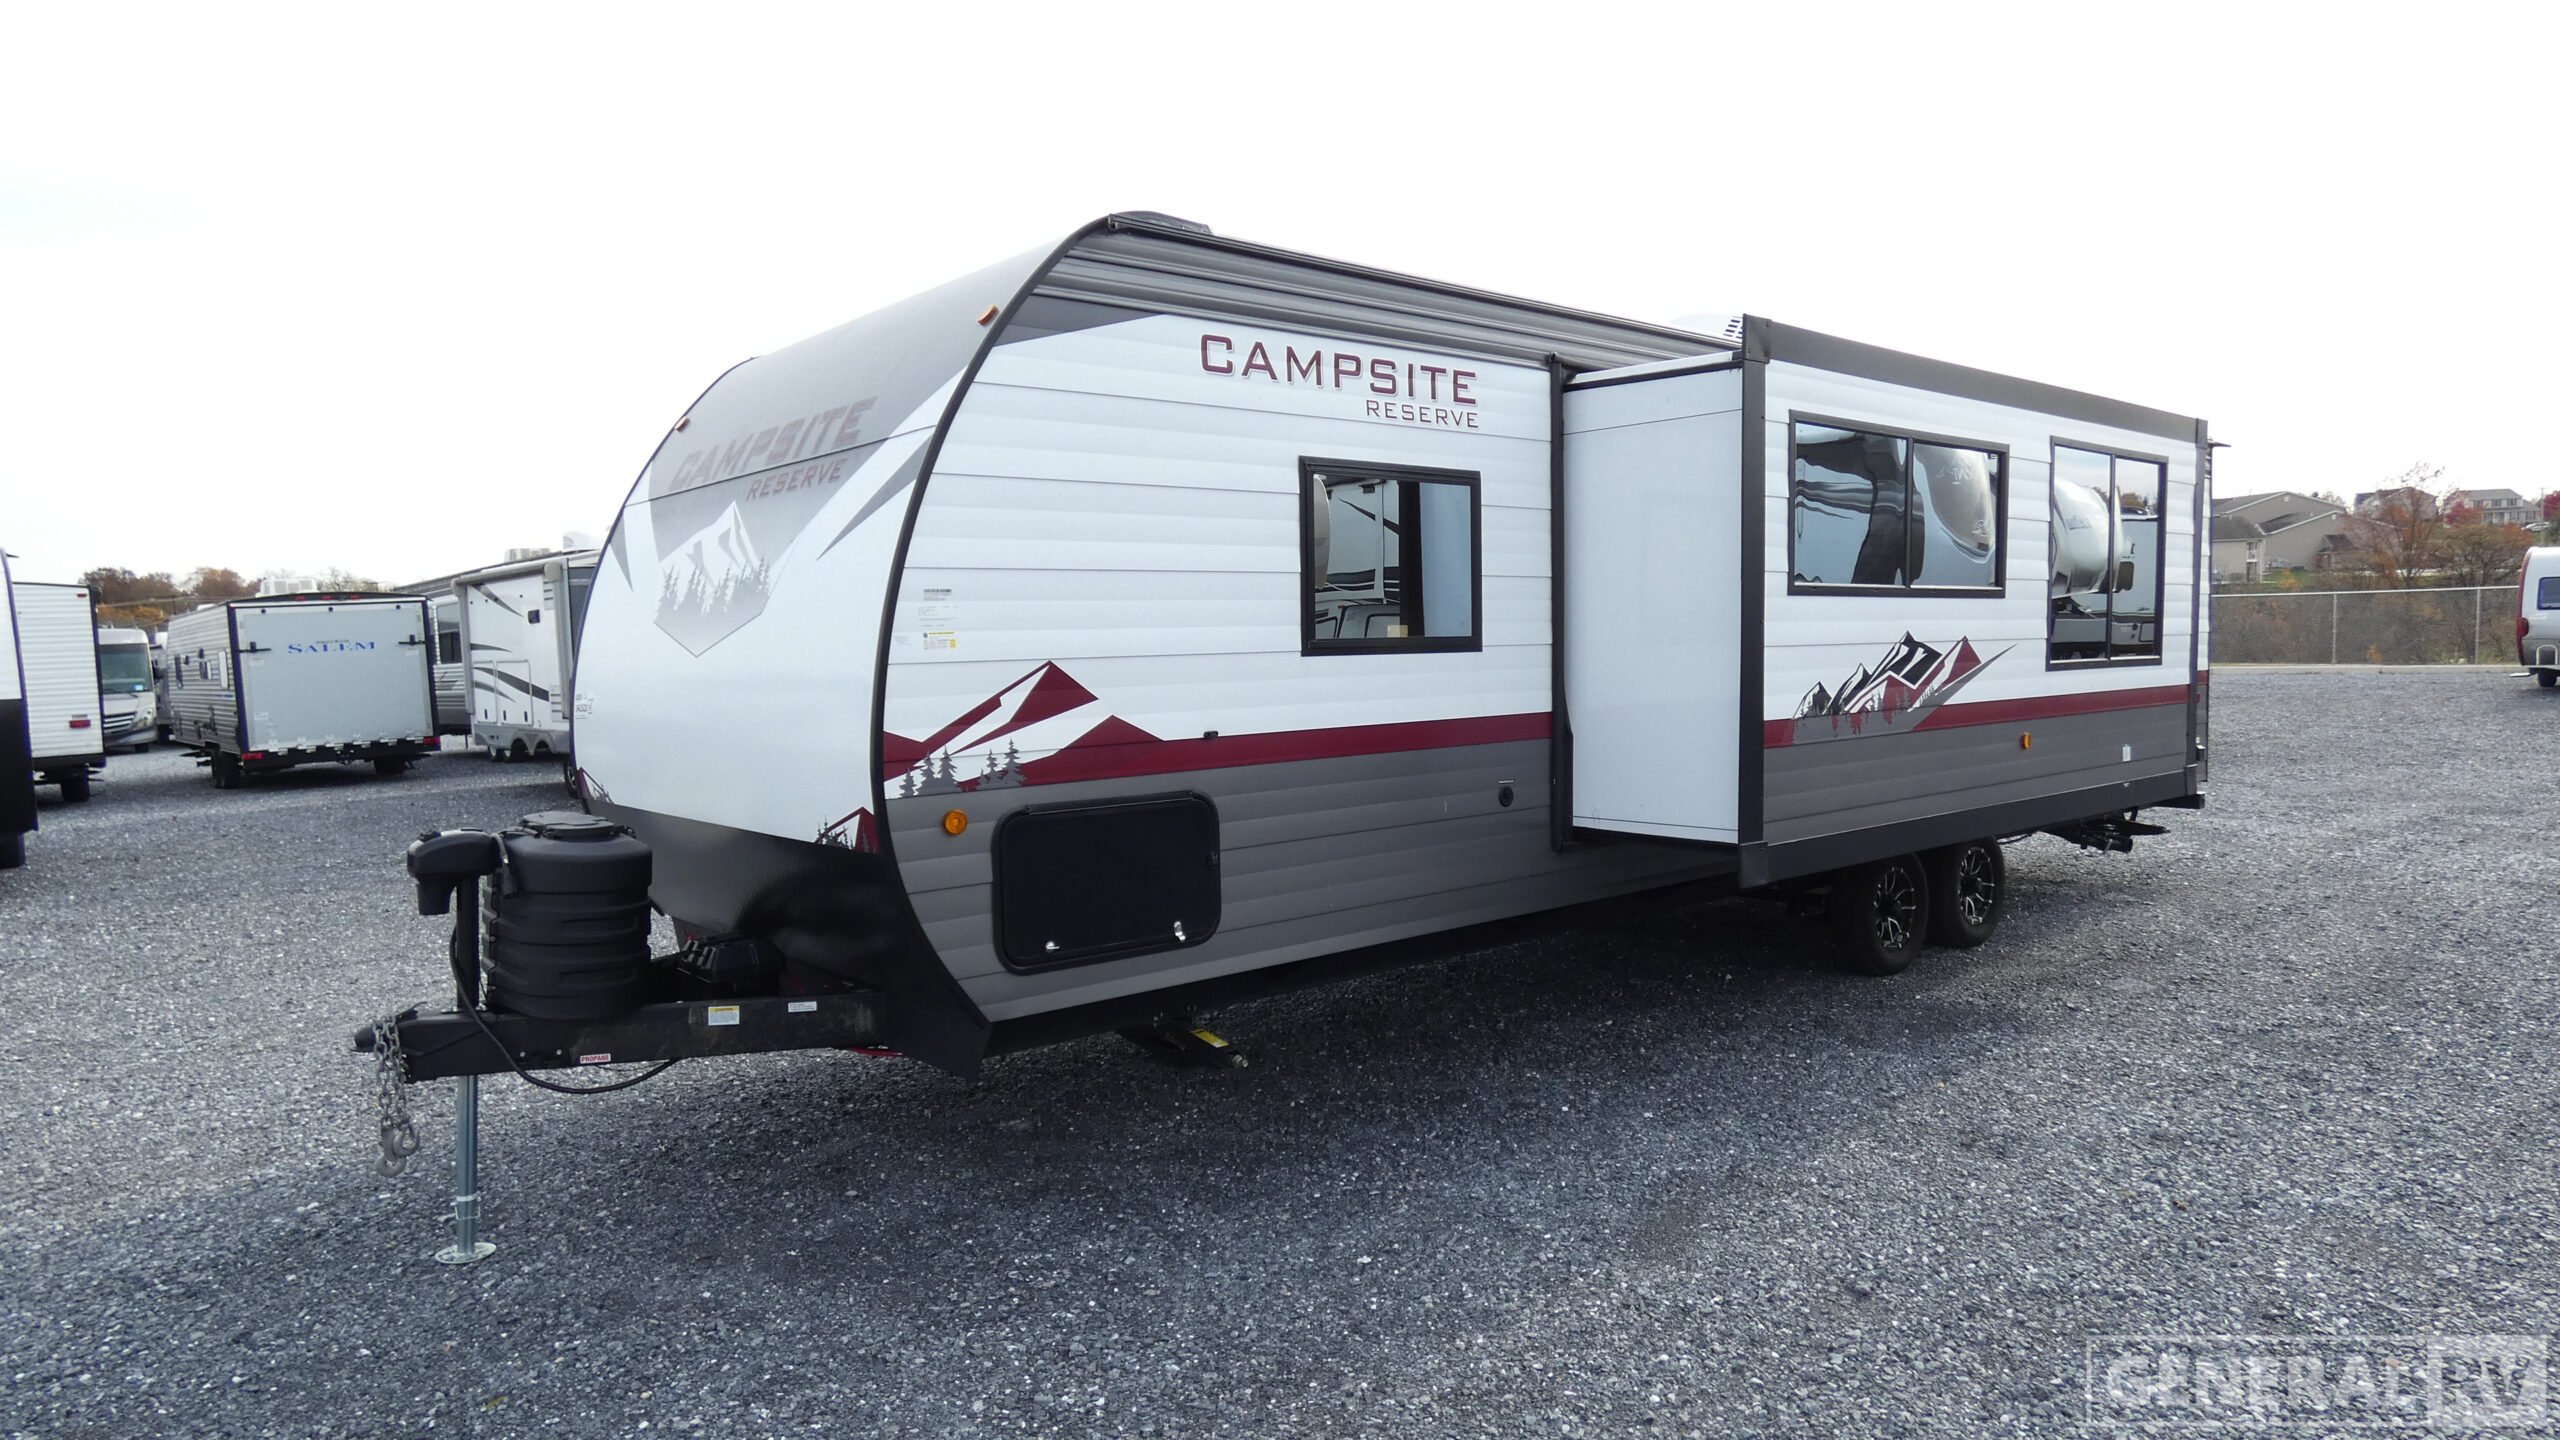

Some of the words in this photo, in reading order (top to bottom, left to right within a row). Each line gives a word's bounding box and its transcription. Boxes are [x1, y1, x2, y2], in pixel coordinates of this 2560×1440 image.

[1200, 333, 1477, 405] CAMPSITE
[1366, 399, 1479, 429] RESERVE
[667, 396, 878, 492] CAMPSITE
[745, 457, 849, 501] RESERVE
[288, 641, 375, 654] SALEM
[581, 1054, 609, 1063] PROPANE
